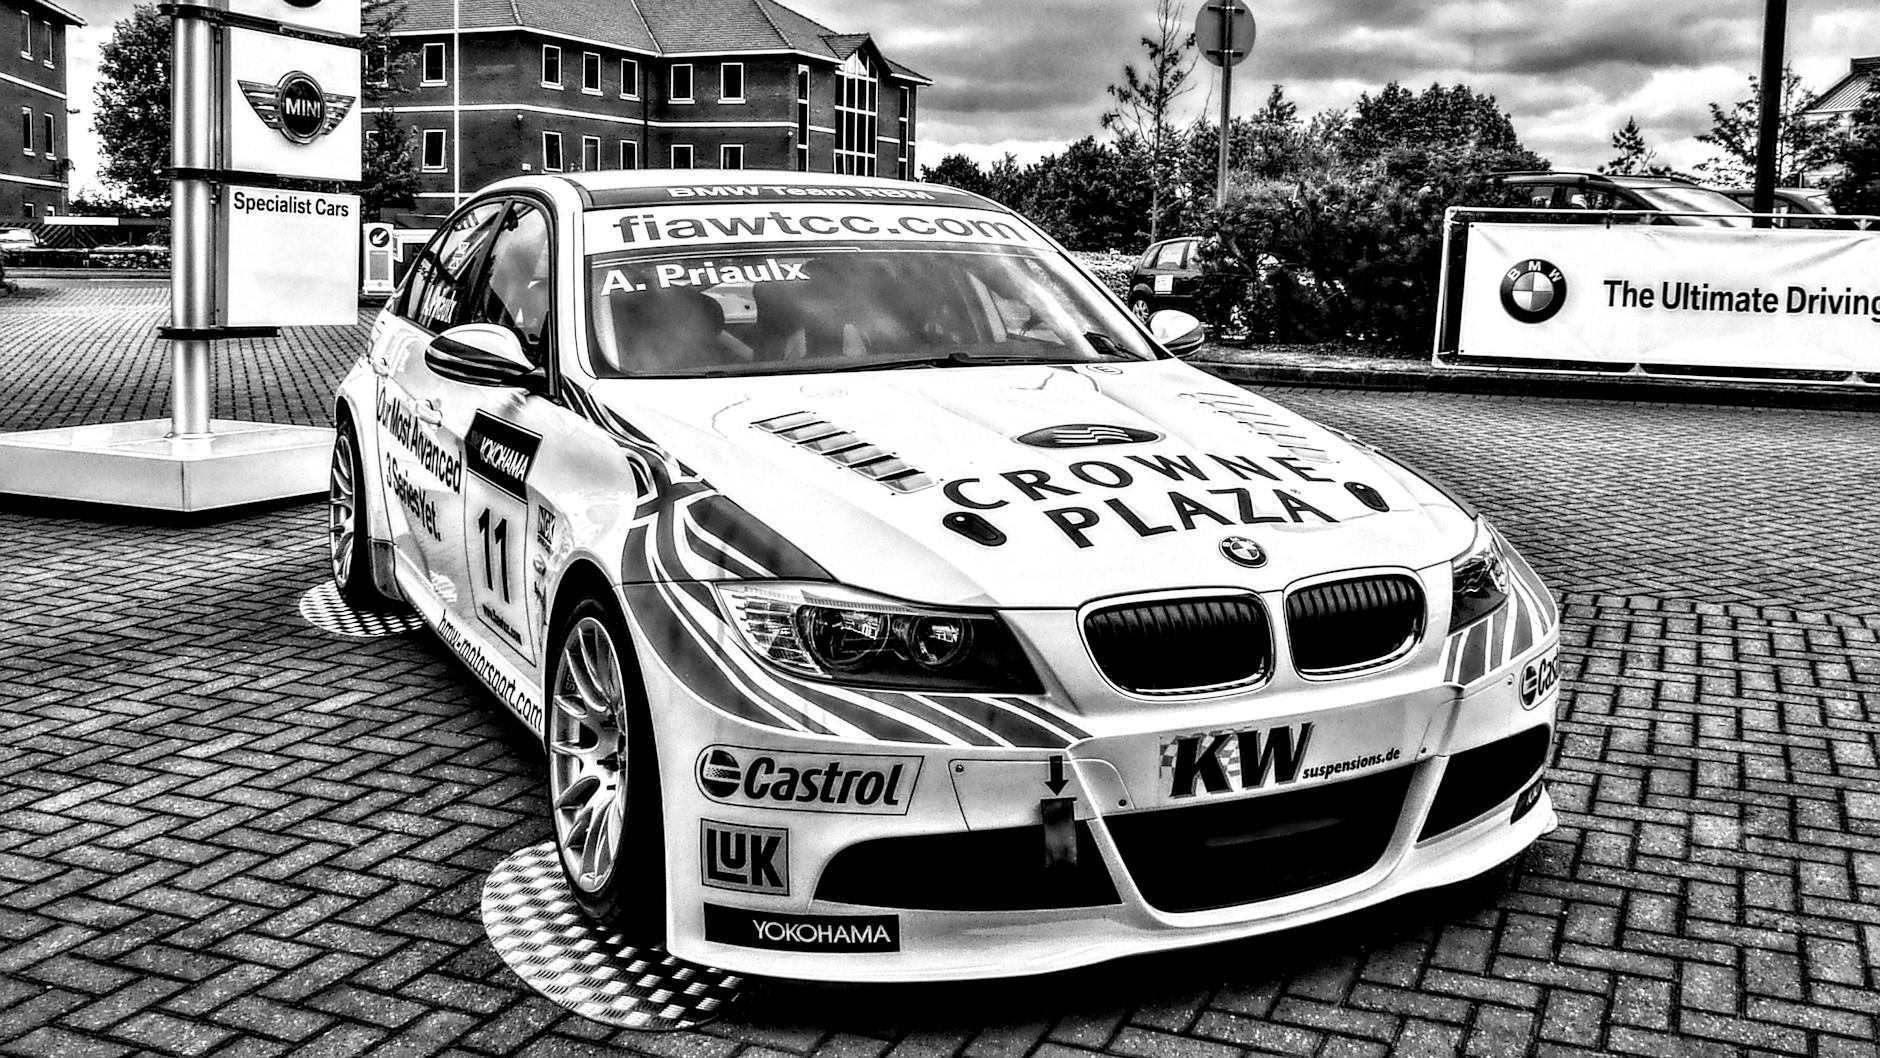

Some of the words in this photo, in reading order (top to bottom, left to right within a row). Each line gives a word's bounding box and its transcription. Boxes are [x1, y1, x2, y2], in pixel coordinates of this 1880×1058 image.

[286, 97, 321, 120] MINI
[233, 192, 312, 215] Specialist
[315, 198, 349, 217] Cars
[667, 186, 760, 198] BMW
[762, 185, 857, 197] Team
[857, 188, 936, 201] RBM
[613, 210, 1028, 244] fiawtcc.com
[601, 269, 647, 296] A.
[656, 259, 810, 289] Priaulx
[1507, 260, 1562, 283] BMW
[1604, 279, 1654, 309] The
[1662, 281, 1779, 314] Ultimate
[390, 397, 411, 449] Most
[479, 436, 529, 481] YOKOHAMA
[943, 454, 1336, 510] CROWNE
[1043, 488, 1340, 549] PLAZA
[478, 507, 510, 604] 11
[437, 609, 543, 732] bmw-motorsport.com
[744, 756, 903, 806] Castrol
[1169, 722, 1315, 799] KW
[1302, 747, 1400, 782] suspensions.de
[753, 919, 892, 944] YOKOHAMA
